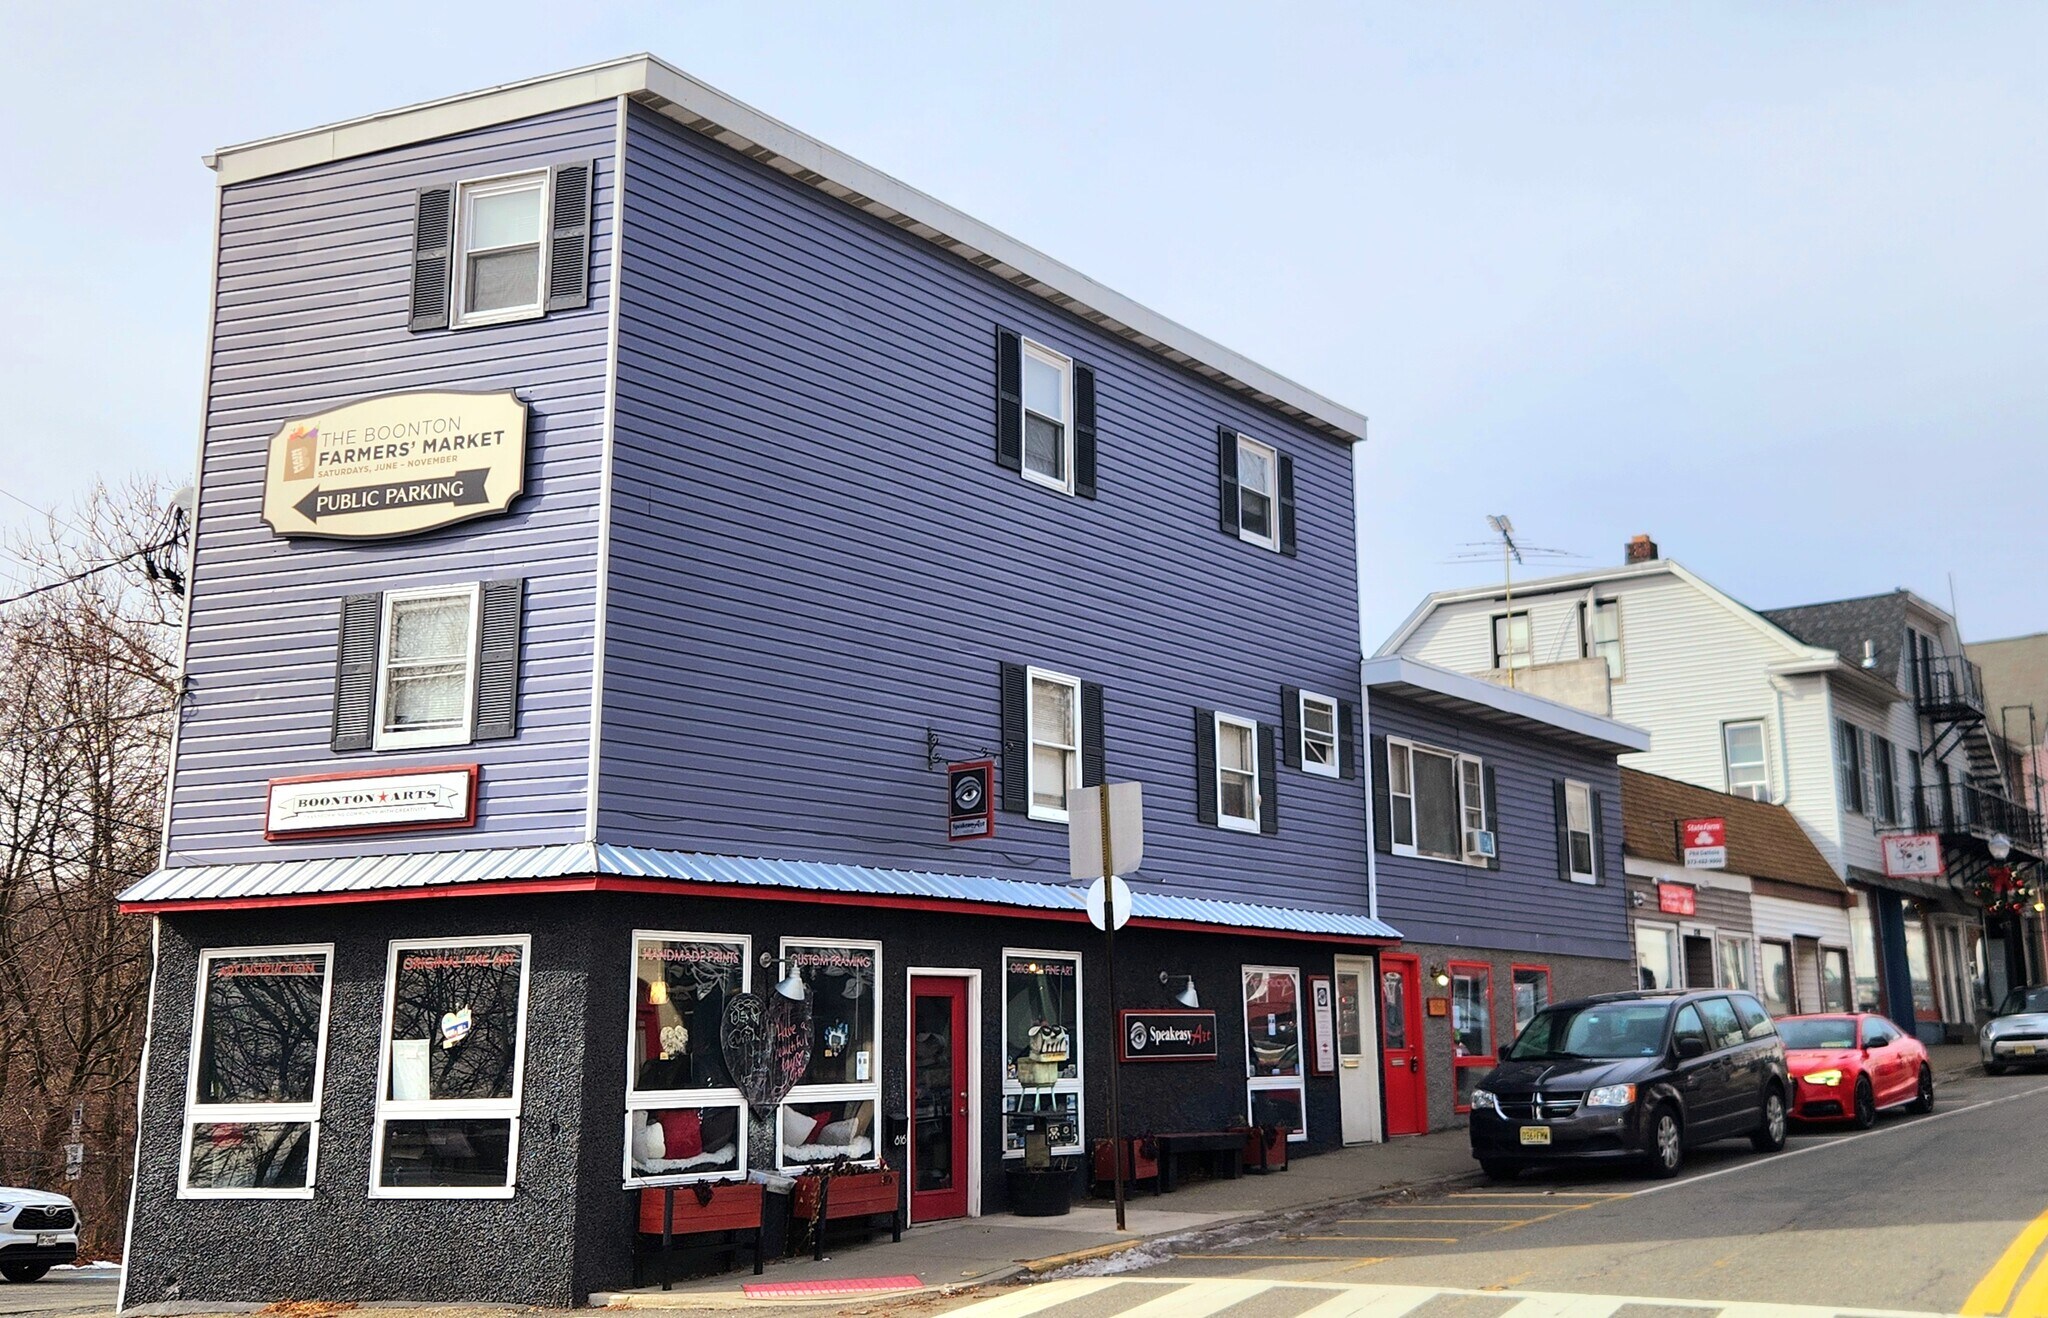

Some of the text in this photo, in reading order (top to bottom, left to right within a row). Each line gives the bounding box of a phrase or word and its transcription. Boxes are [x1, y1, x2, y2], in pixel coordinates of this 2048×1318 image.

[321, 416, 461, 447] THE BOONTON
[422, 430, 505, 454] MARKET
[317, 466, 372, 478] SATURDAYS,
[374, 461, 398, 472] JUNE
[407, 455, 458, 468] NOVEMBER
[316, 480, 464, 512] PUBLIC PARKING
[298, 789, 437, 808] BOONTON ARTS
[403, 955, 461, 970] ORIGINAL
[492, 953, 516, 967] ART
[642, 947, 739, 963] HANDMADE PRINTS
[242, 962, 316, 976] INSTRUCTION
[1045, 965, 1060, 975] FINE
[1060, 965, 1074, 975] ART
